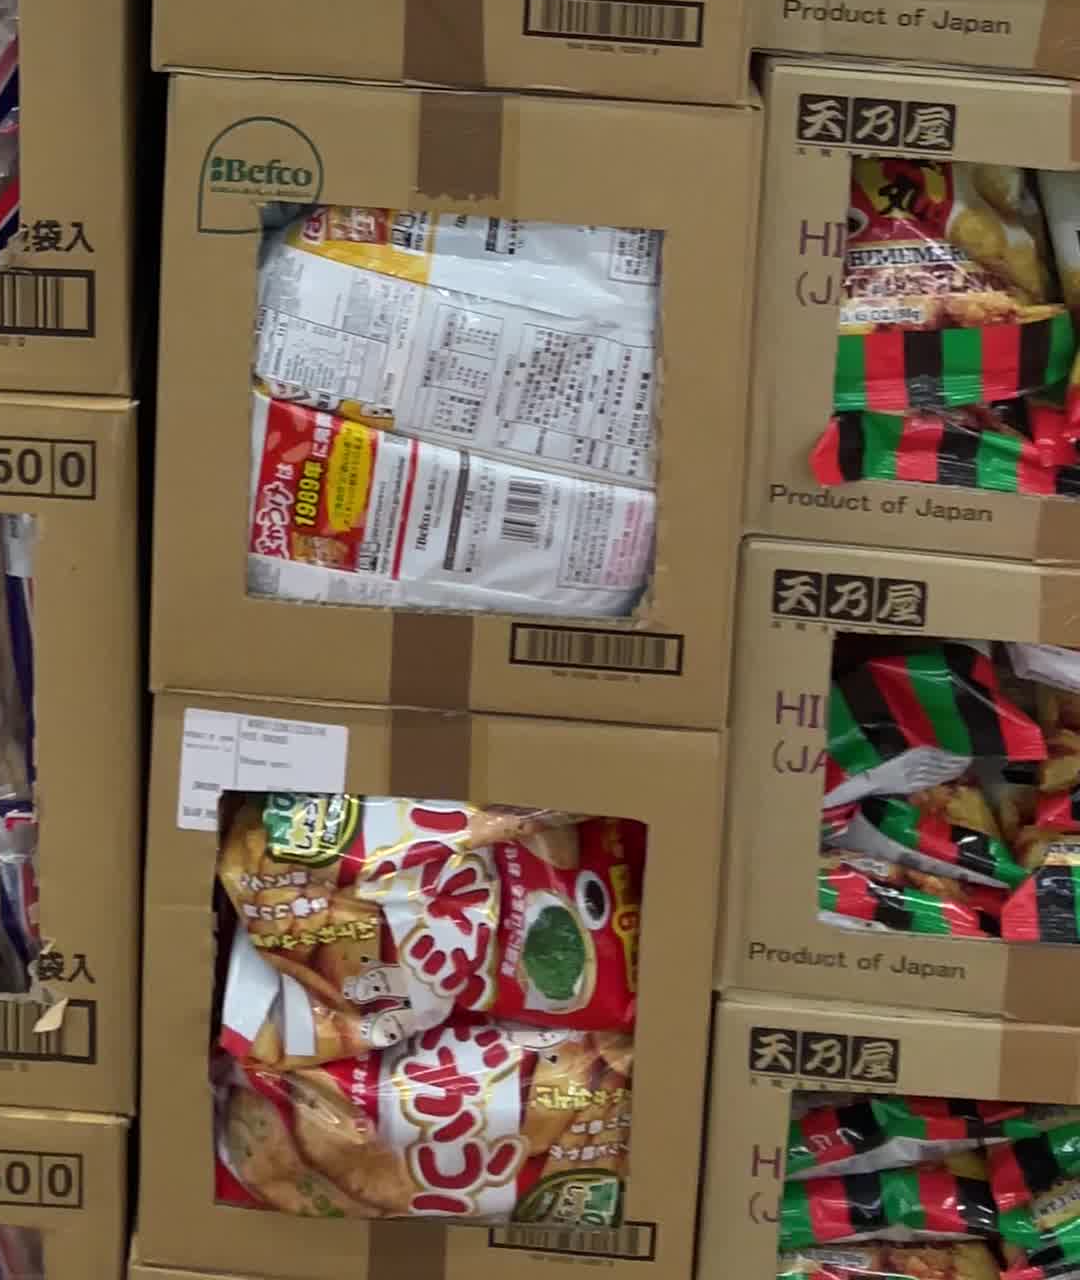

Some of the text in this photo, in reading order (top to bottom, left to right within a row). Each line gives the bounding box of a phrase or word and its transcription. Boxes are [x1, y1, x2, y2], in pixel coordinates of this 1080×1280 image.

[782, 0, 1012, 37] Product of Japan
[798, 93, 957, 150] 天乃屋
[224, 157, 313, 187] Befco
[60, 450, 86, 489] 0
[769, 484, 993, 523] Product of Japan
[774, 569, 927, 626] 天乃屋
[748, 941, 967, 980] Product of Japan
[749, 1027, 900, 1082] 天乃屋
[47, 1163, 74, 1198] 0
